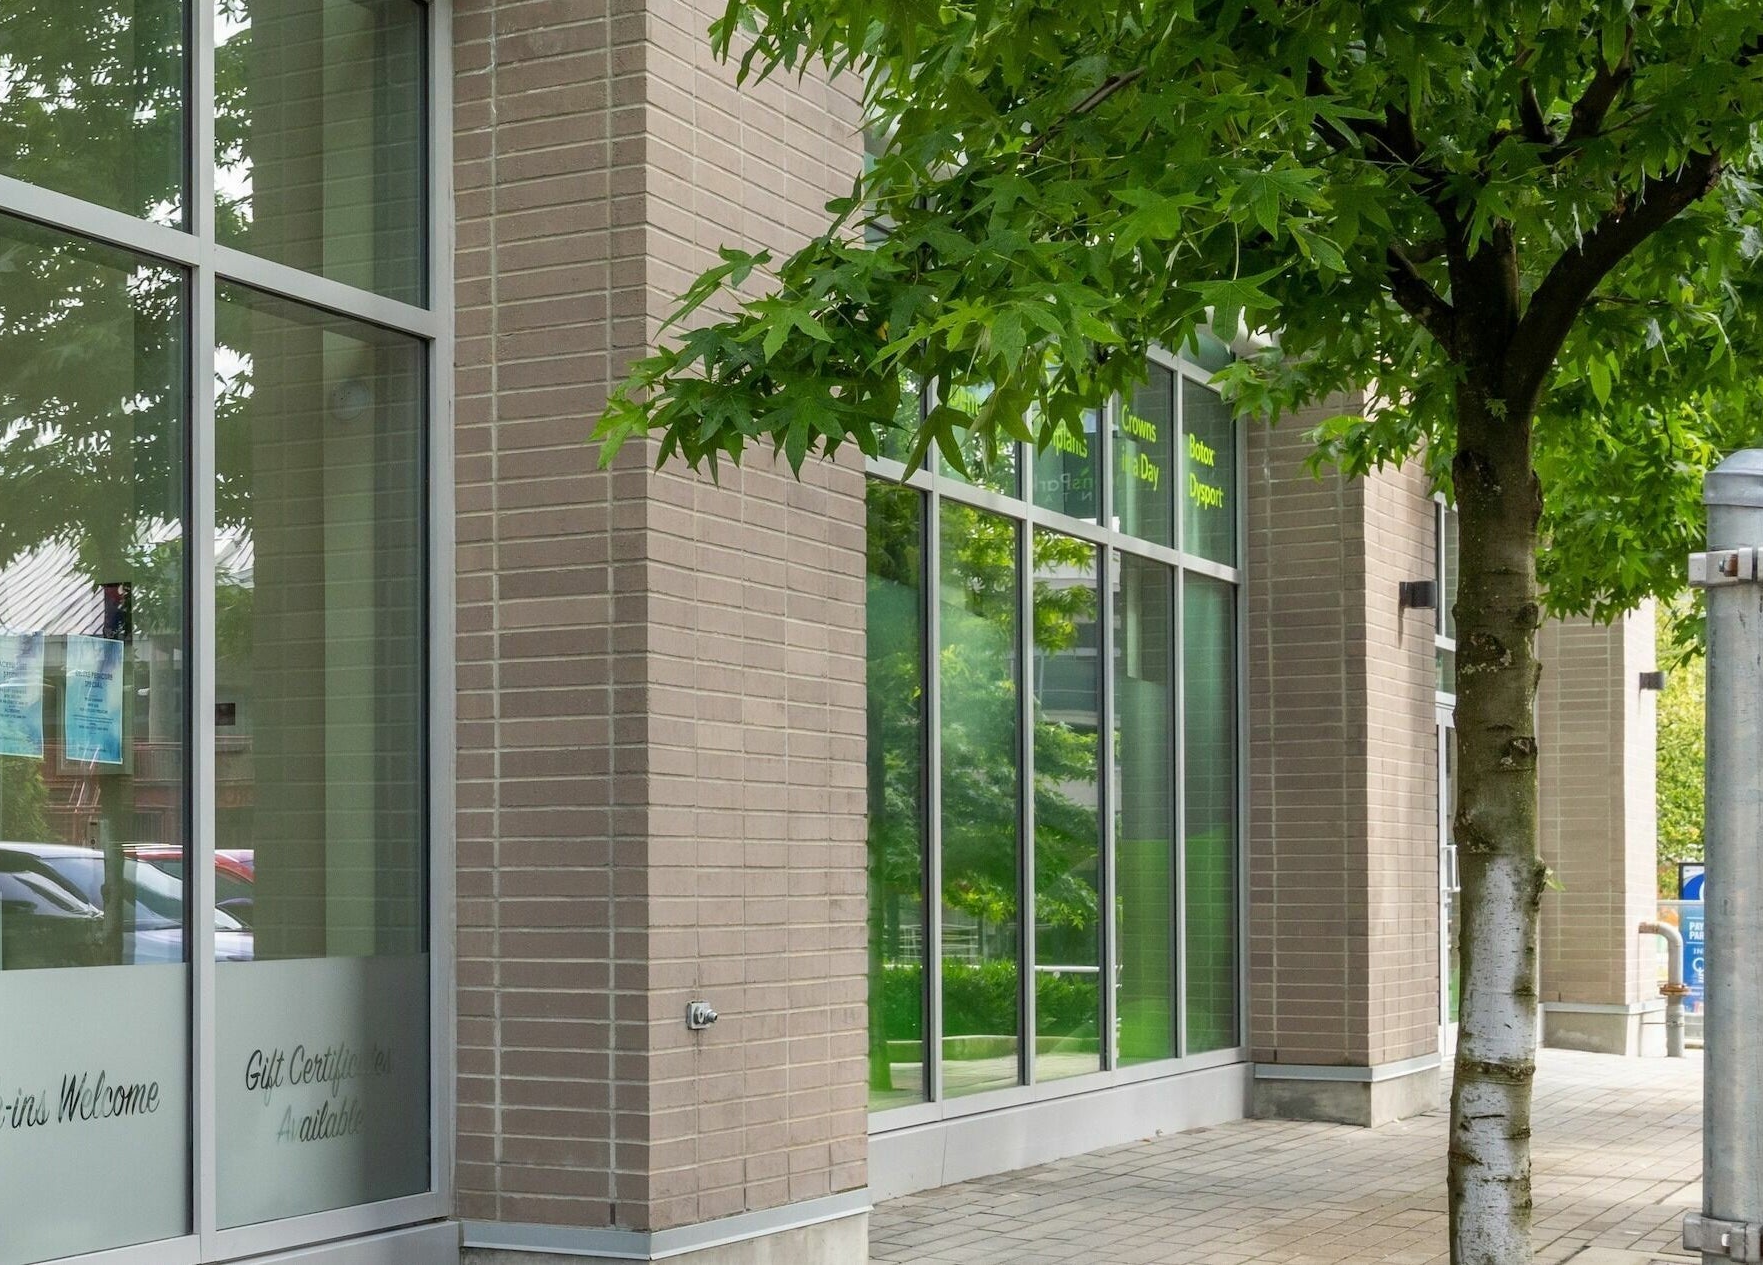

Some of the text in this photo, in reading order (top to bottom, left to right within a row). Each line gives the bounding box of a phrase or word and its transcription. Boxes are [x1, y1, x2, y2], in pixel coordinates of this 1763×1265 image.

[1122, 404, 1156, 443] Crowns
[1189, 433, 1215, 467] Botox
[1140, 453, 1159, 491] Day
[1189, 472, 1224, 510] Dysport
[245, 1048, 285, 1107] Gift
[58, 1070, 160, 1124] Welcome
